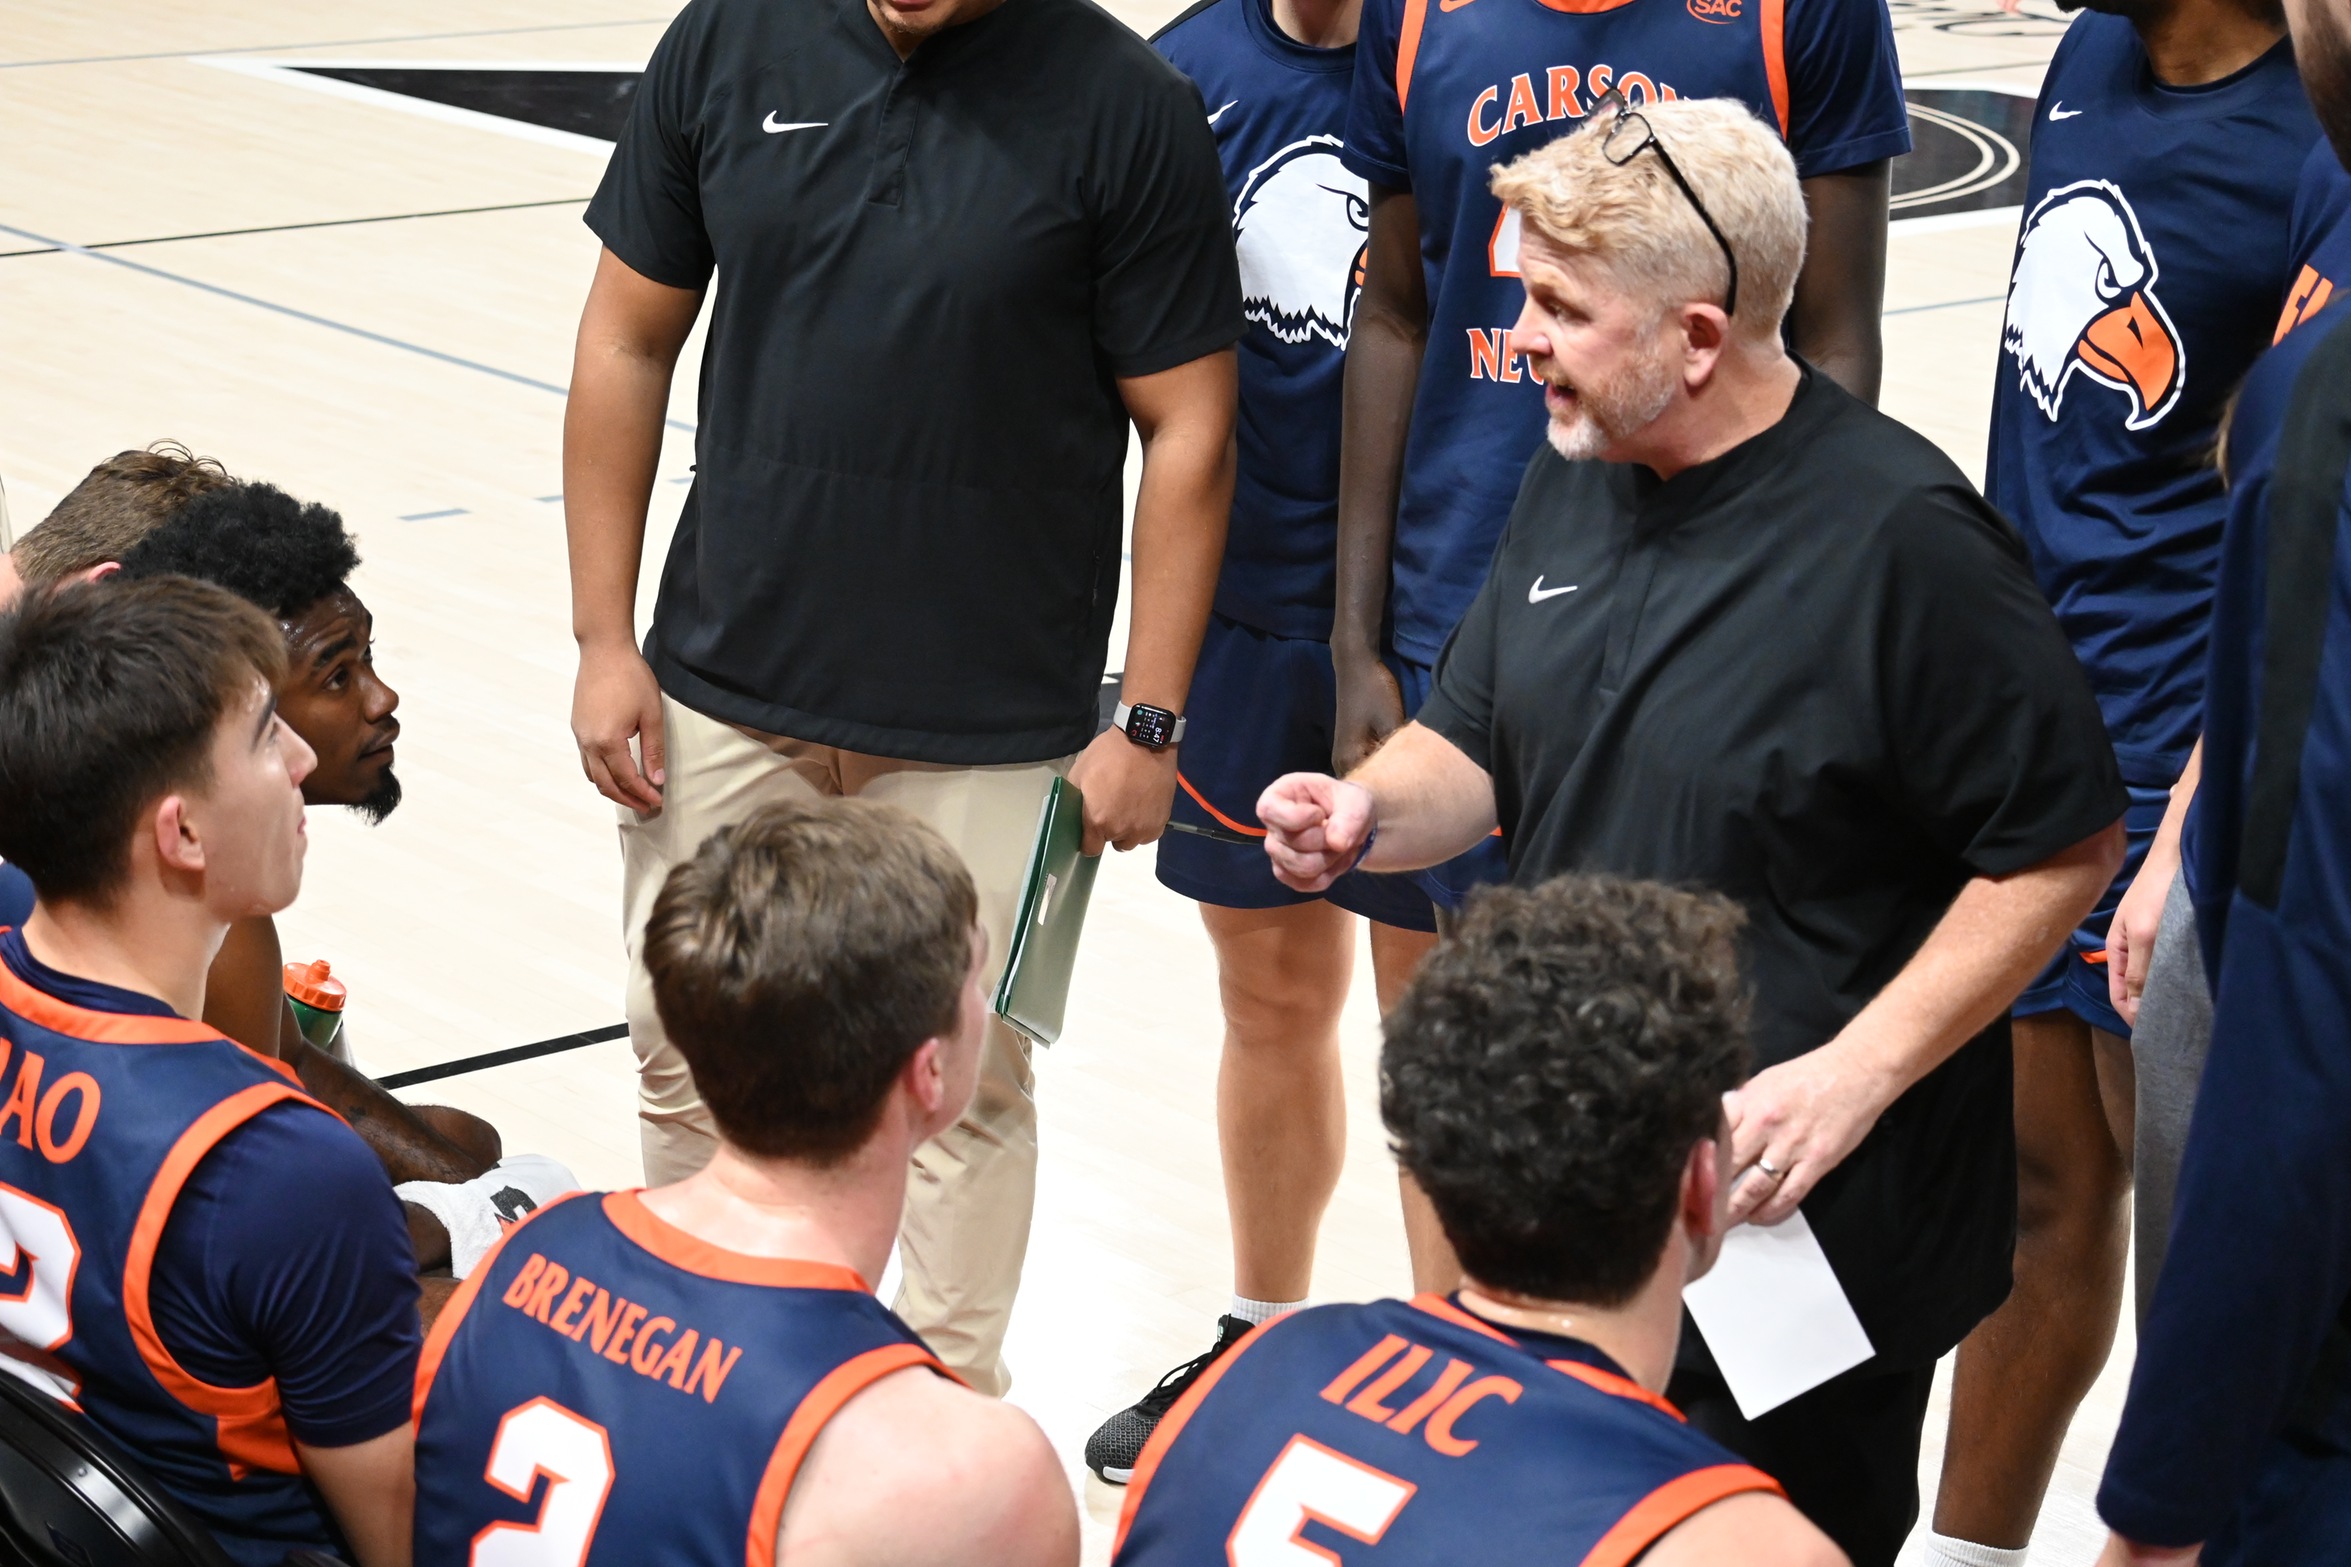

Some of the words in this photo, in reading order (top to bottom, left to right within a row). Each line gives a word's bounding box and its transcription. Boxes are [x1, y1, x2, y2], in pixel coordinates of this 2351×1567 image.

[1694, 0, 1742, 17] SAC
[503, 1253, 743, 1403] BRENEGAN
[1319, 1333, 1523, 1457] ILIC
[468, 1395, 616, 1567] 2
[1225, 1432, 1418, 1567] 5
